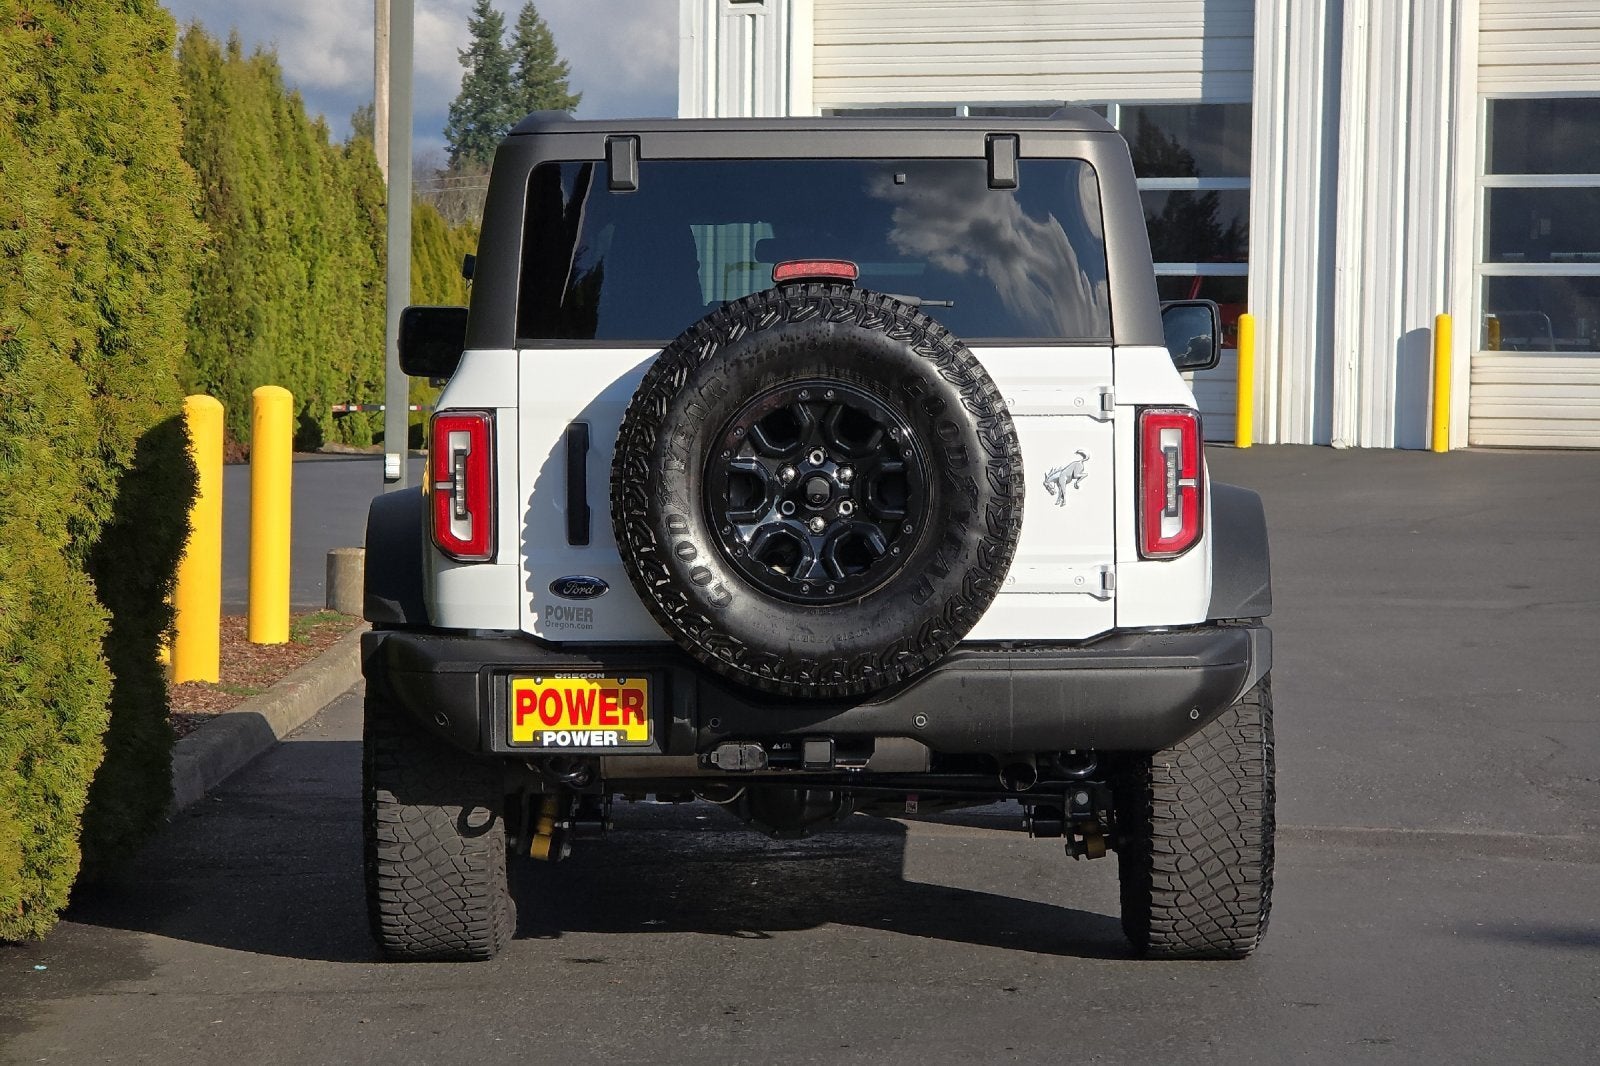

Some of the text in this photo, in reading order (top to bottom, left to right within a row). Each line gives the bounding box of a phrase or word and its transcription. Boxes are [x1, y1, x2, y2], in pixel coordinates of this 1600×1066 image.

[563, 581, 594, 595] Ford
[545, 605, 594, 622] POWER
[545, 620, 593, 630] Oregon.com
[516, 688, 646, 726] POWER
[543, 730, 618, 746] POWER
